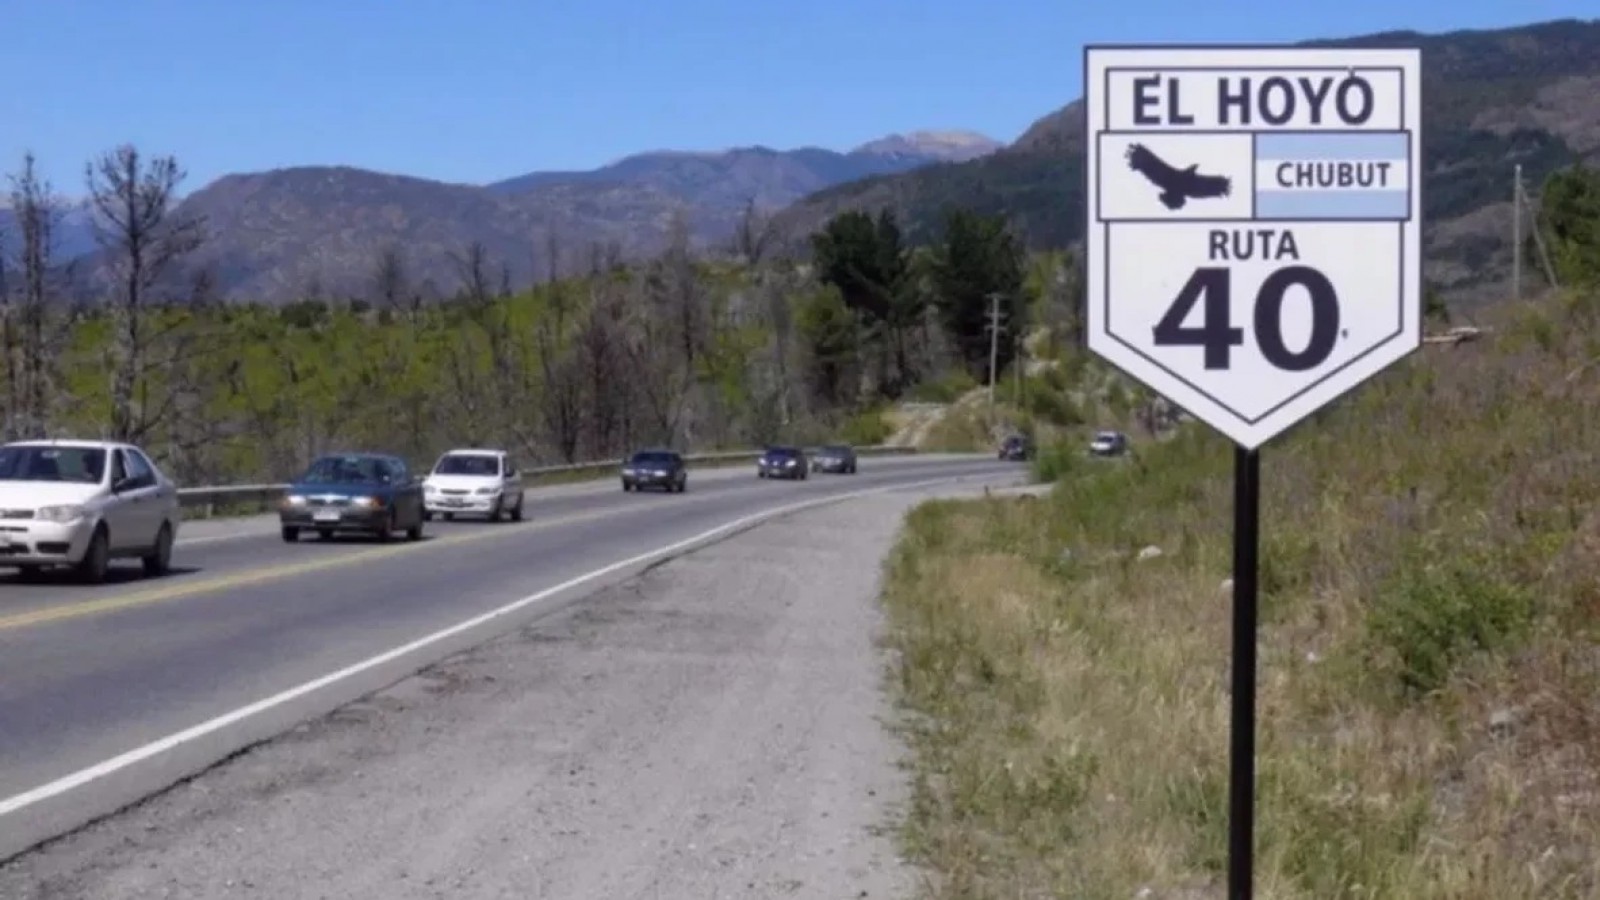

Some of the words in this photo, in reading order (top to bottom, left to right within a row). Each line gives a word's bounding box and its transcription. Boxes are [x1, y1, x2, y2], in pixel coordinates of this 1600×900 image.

[1133, 76, 1194, 125] EL
[1217, 76, 1374, 126] HOYO
[1277, 162, 1390, 187] CHUBUT
[1208, 230, 1300, 260] RUTA
[1152, 265, 1340, 372] 40
